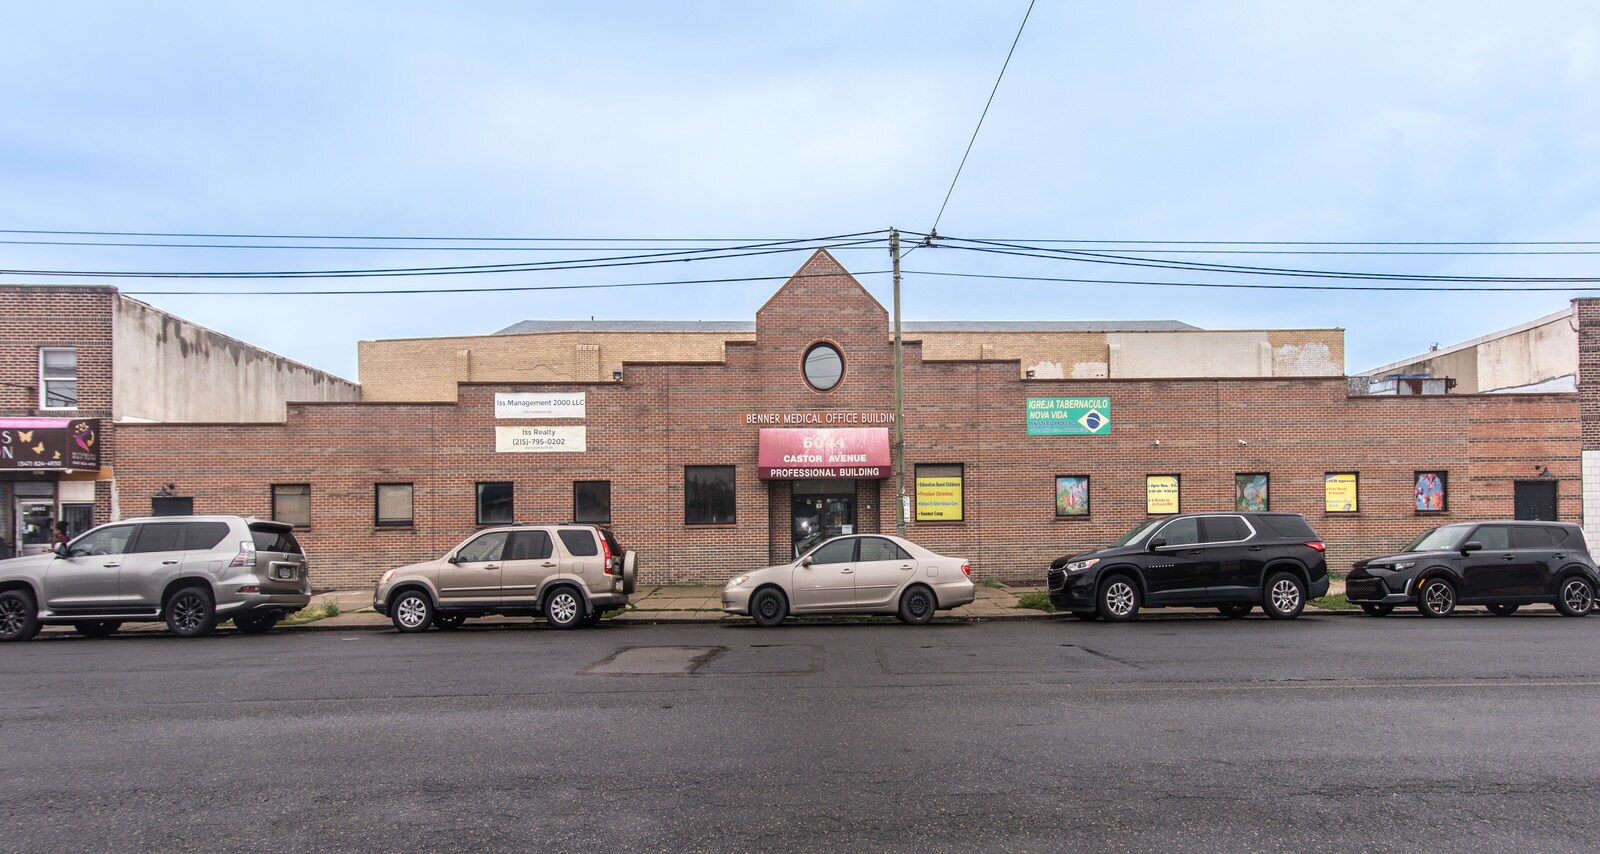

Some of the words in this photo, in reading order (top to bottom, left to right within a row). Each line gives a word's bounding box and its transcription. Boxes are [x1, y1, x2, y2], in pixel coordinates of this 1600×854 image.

[507, 399, 552, 408] Management
[1028, 400, 1055, 409] IGREJA
[1056, 399, 1108, 409] TABERNACULO
[746, 413, 781, 424] BENNER
[783, 413, 823, 424] MEDICAL
[825, 412, 858, 423] OFFICE
[1029, 411, 1050, 419] NOVA
[1051, 410, 1068, 419] VIDA
[533, 428, 556, 436] Realty
[512, 438, 566, 446] (215)-795-0202
[783, 454, 823, 463] CASTOR
[829, 454, 867, 462] AVENUE
[770, 468, 837, 477] PROFESSIONAL
[839, 467, 879, 476] BUILDING
